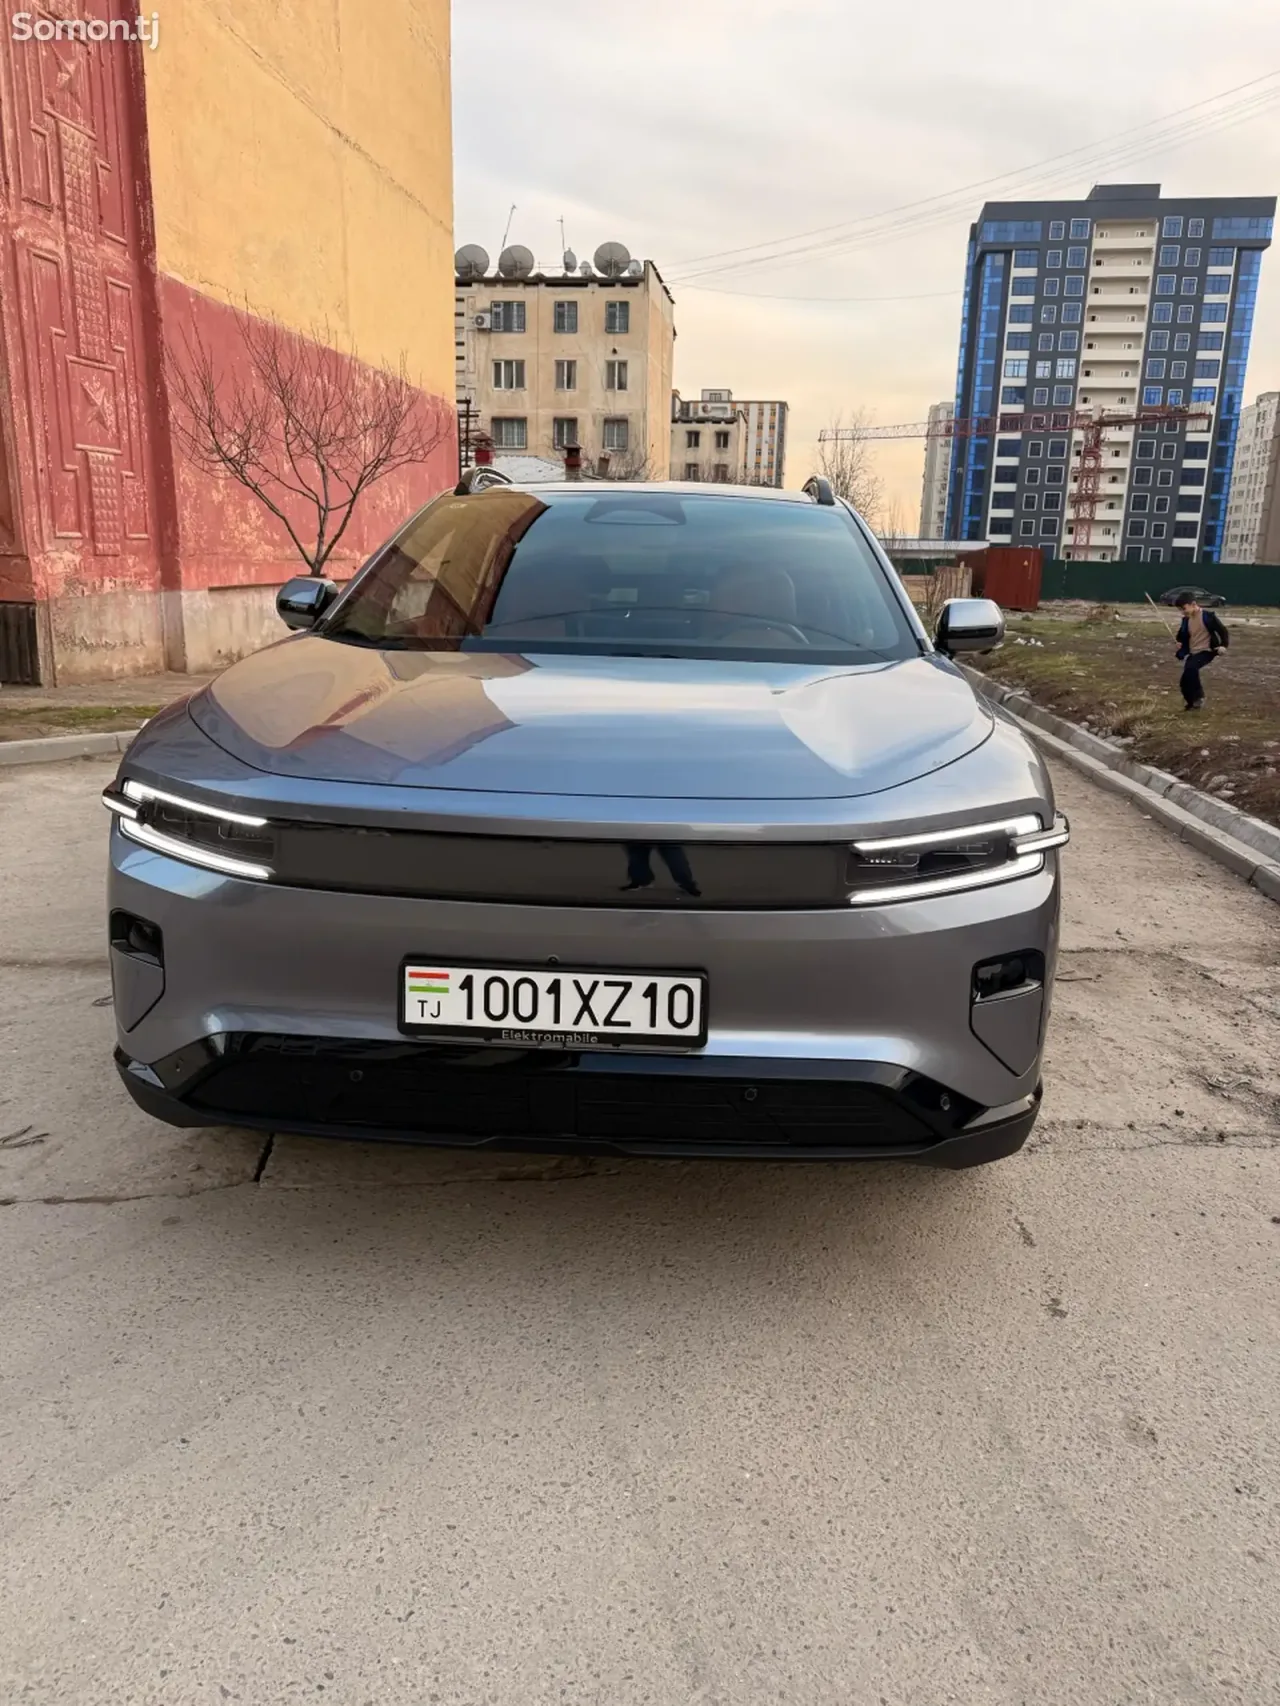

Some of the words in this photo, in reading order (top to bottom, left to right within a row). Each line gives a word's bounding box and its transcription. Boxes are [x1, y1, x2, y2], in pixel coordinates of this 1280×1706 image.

[417, 999, 441, 1019] TJ
[459, 974, 694, 1029] 1001XZ10
[501, 1029, 598, 1044] Elektromabile
